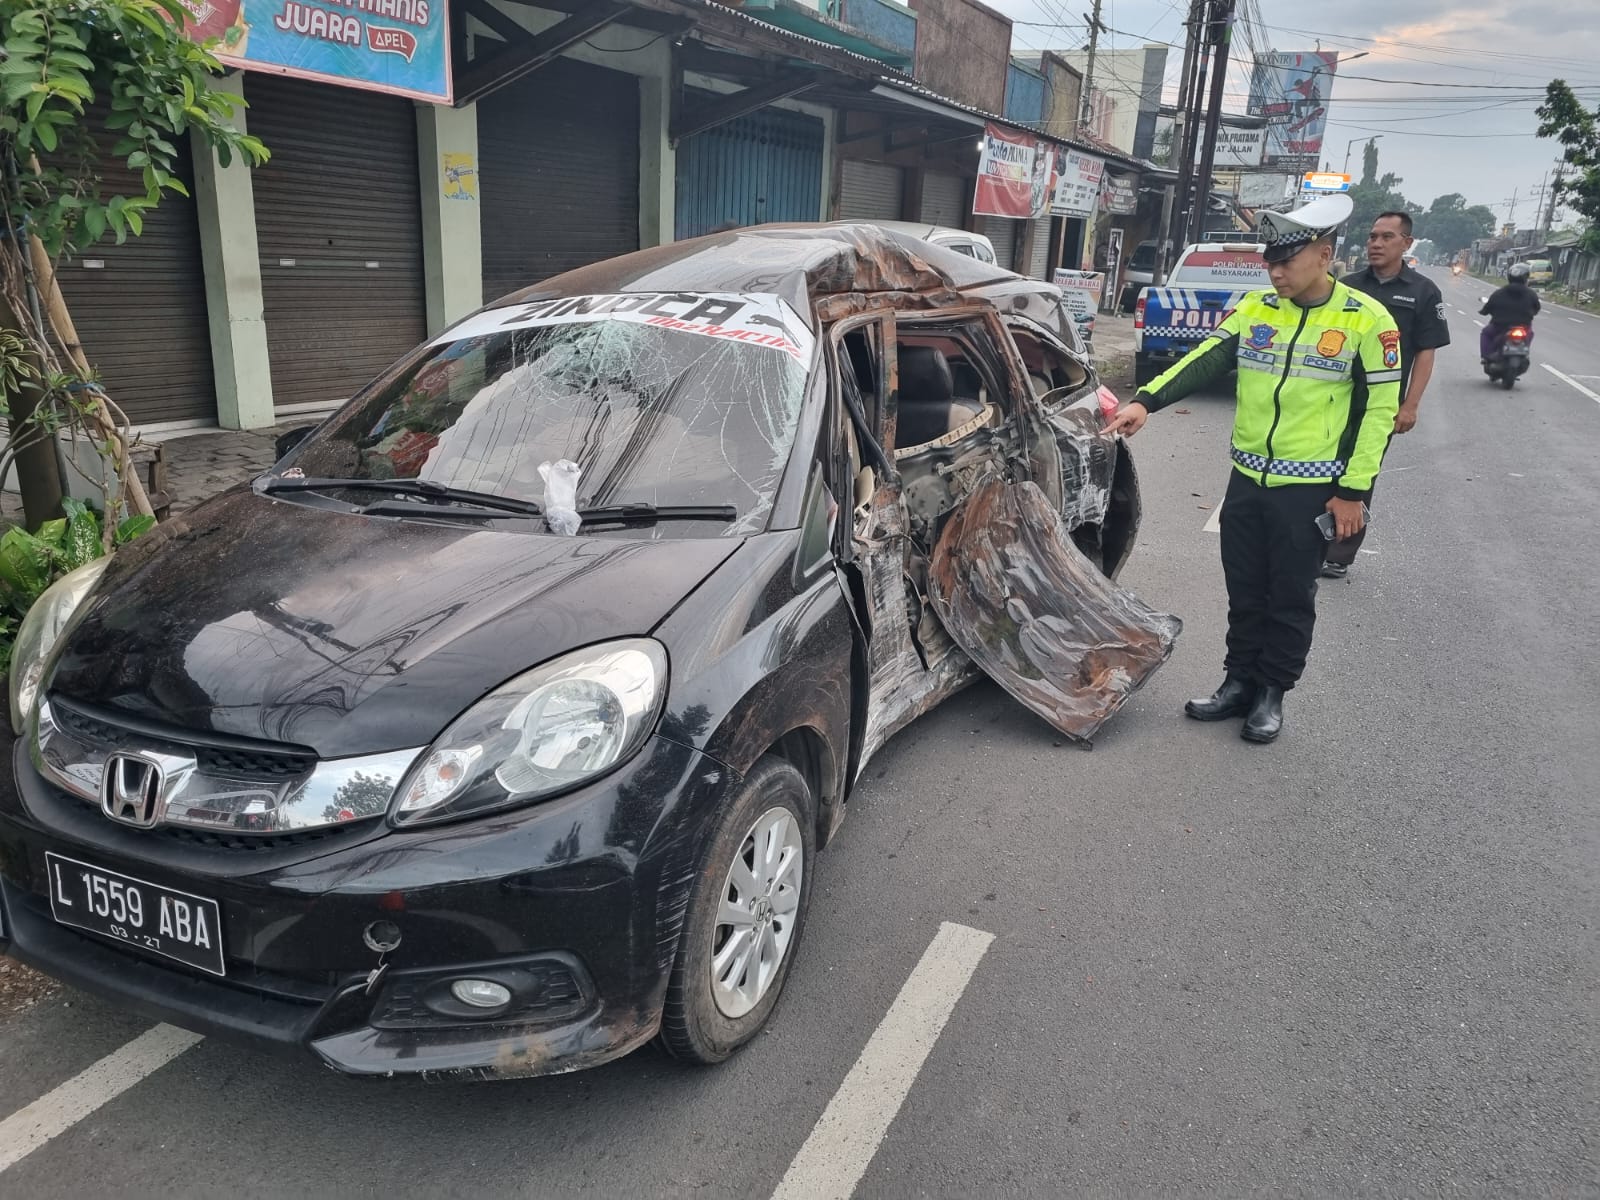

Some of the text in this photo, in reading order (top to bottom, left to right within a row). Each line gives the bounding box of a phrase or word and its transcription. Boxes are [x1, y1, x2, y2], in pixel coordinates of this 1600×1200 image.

[275, 2, 408, 49] JUARA APEL
[1230, 133, 1259, 143] PRATAMA
[1212, 261, 1236, 269] POLRI
[1211, 269, 1262, 278] MASYARAKAT
[1171, 310, 1222, 329] POLI
[1306, 357, 1344, 370] POLRI
[55, 863, 210, 949] L 1559 ABA
